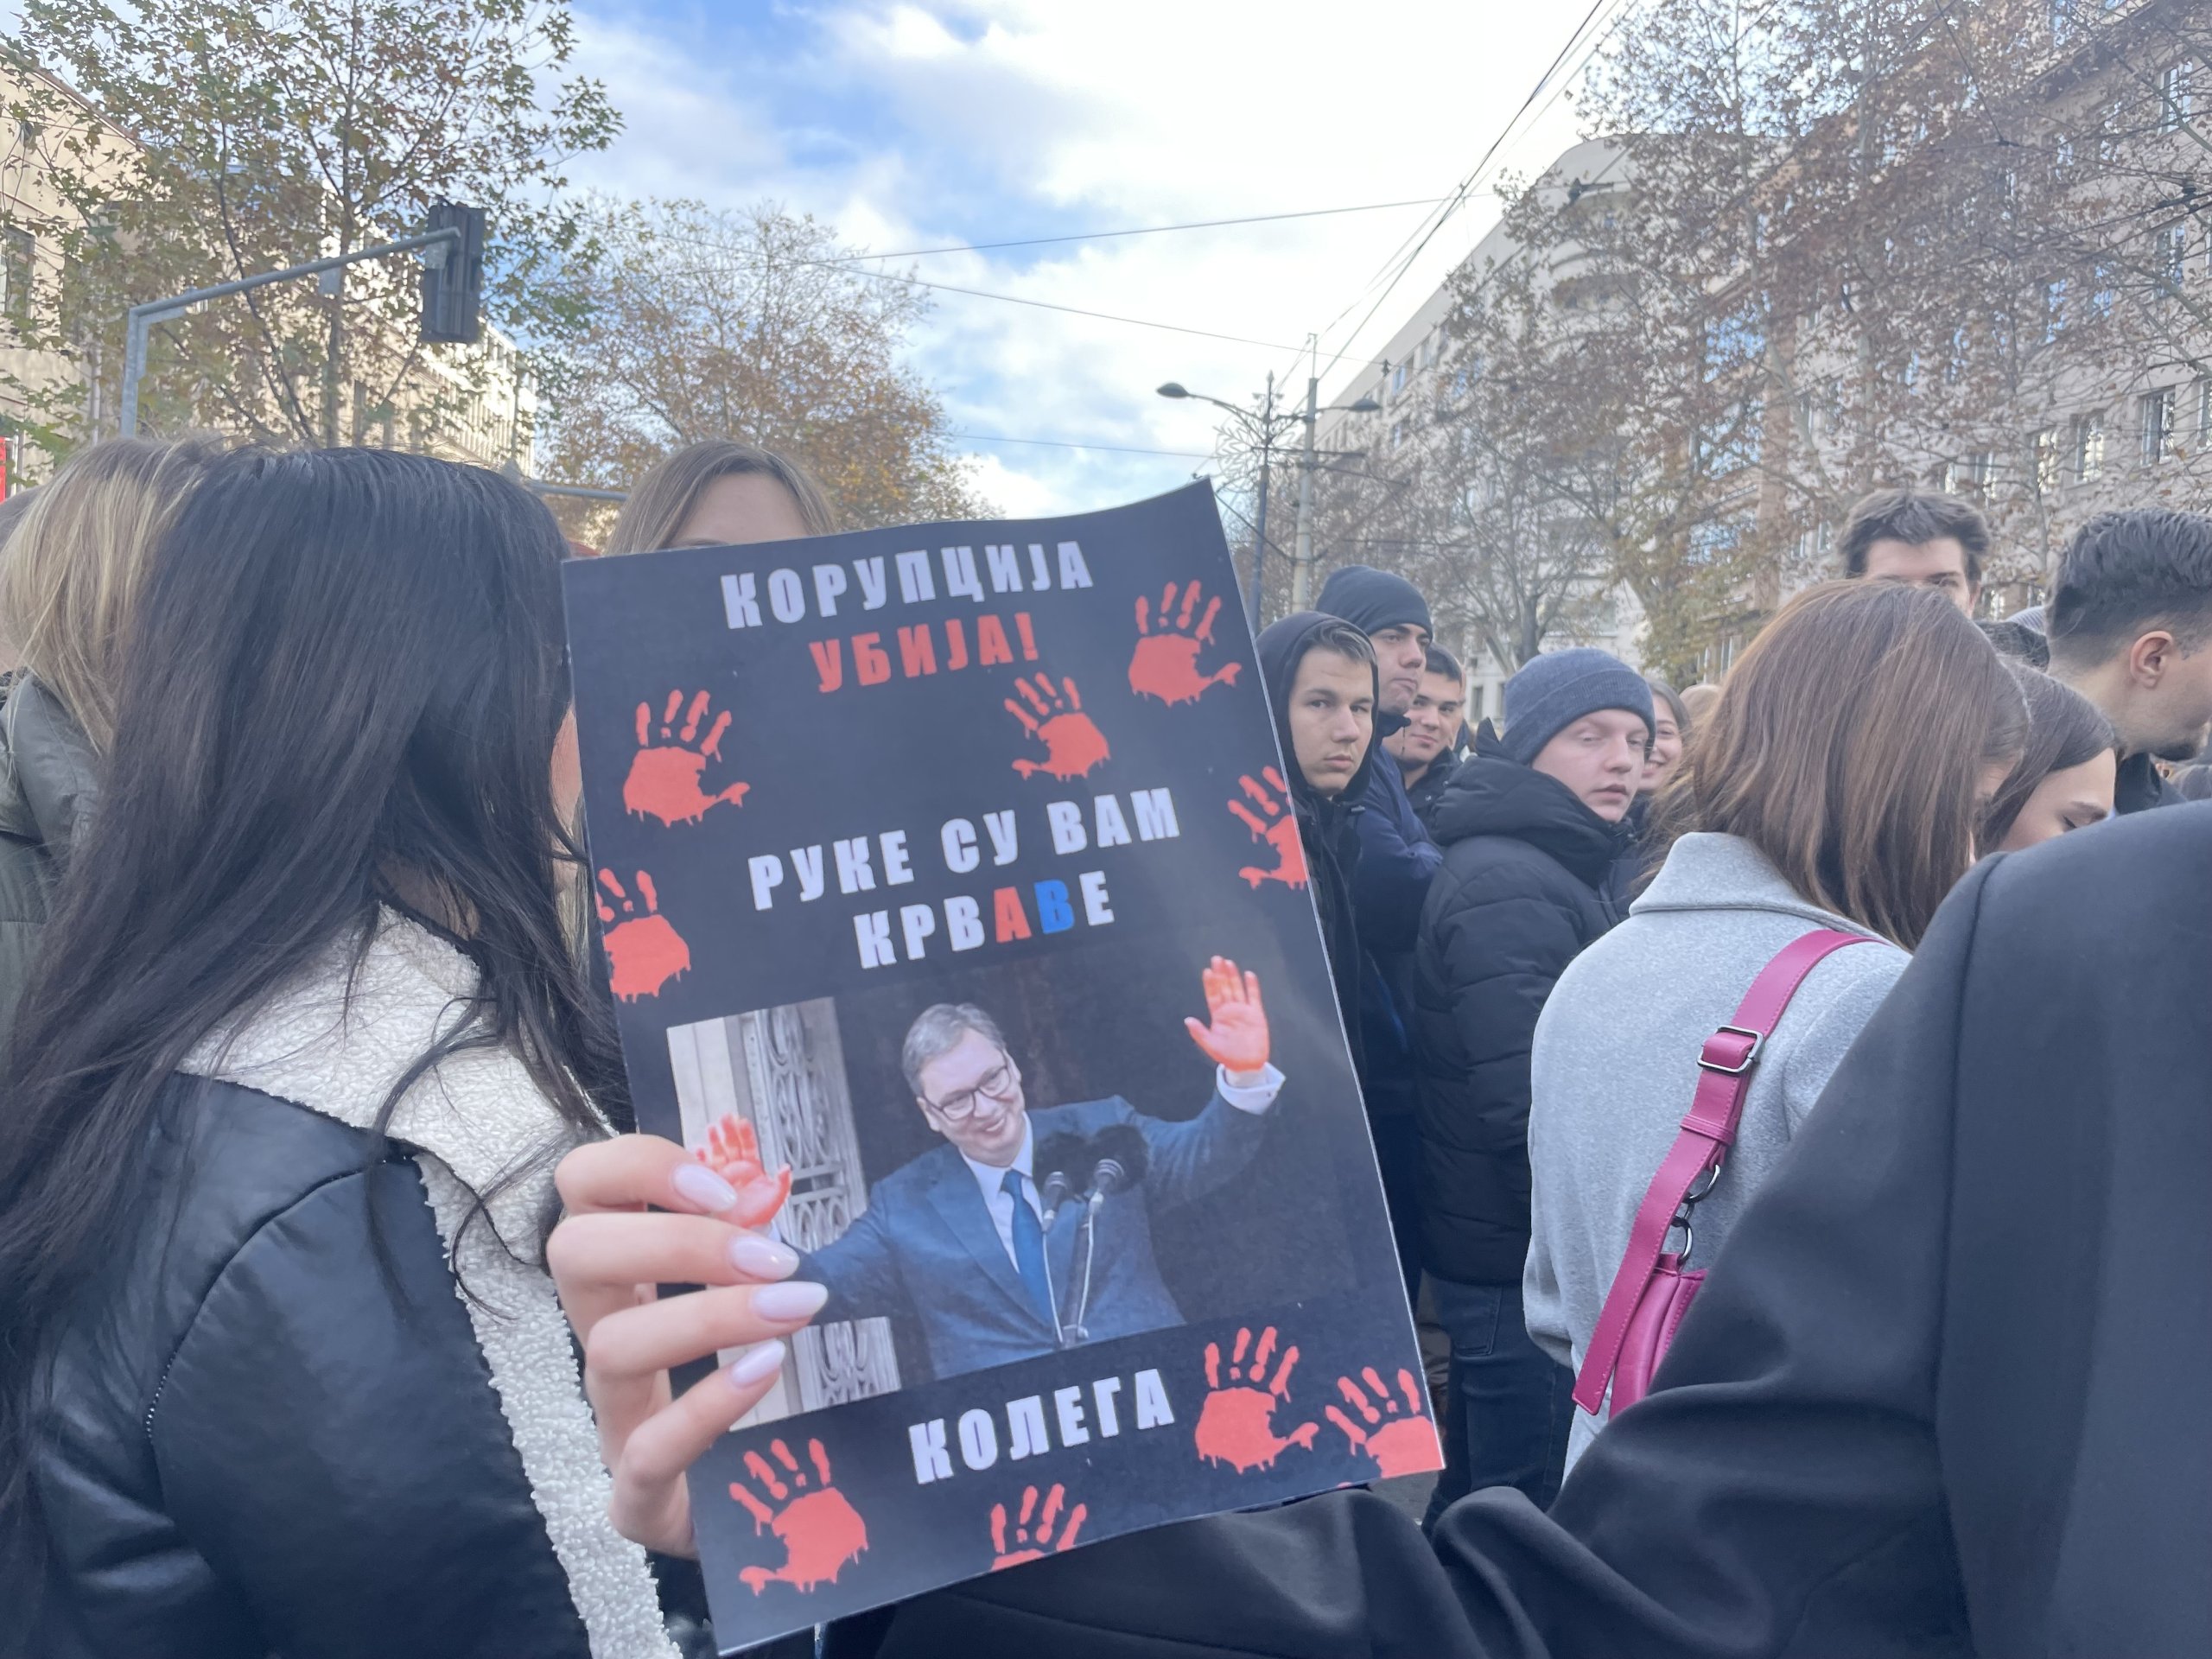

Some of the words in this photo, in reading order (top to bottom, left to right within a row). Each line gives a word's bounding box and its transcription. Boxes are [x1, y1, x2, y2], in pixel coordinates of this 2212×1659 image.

[721, 541, 1093, 629] КОРУПЦИЈА
[809, 613, 1039, 692] УБИЈА!
[748, 830, 914, 911] РУКЕ
[940, 810, 1019, 874] СУ
[1046, 787, 1180, 855] ВАМ
[854, 870, 1115, 969] КРВАВЕ
[908, 1369, 1174, 1484] КОЛЕГА
